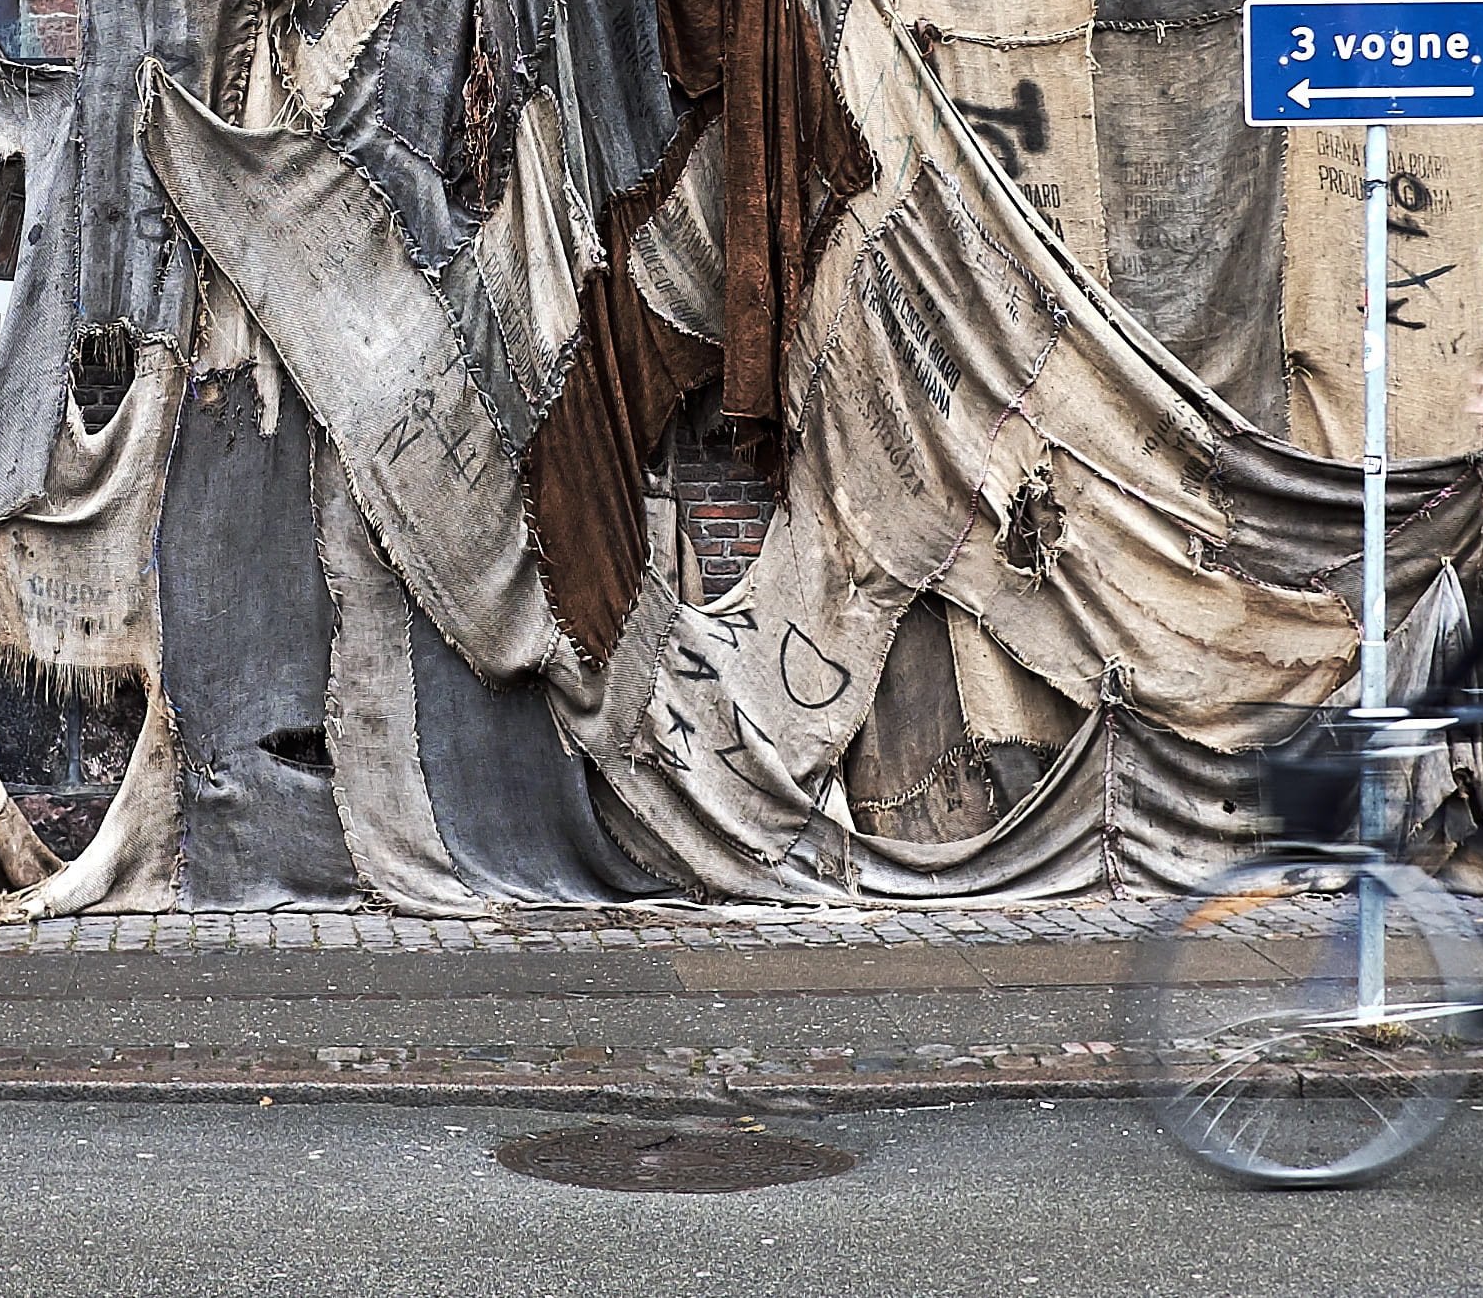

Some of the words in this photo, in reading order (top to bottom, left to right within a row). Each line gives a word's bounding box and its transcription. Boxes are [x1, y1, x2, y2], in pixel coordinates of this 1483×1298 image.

[1291, 26, 1316, 60] 3
[1333, 30, 1471, 69] vogne
[1316, 130, 1361, 167] GHANA
[873, 250, 905, 310] GHANA
[903, 296, 930, 350] COCOA
[928, 338, 961, 393] BOARD
[915, 362, 950, 420] GHANA
